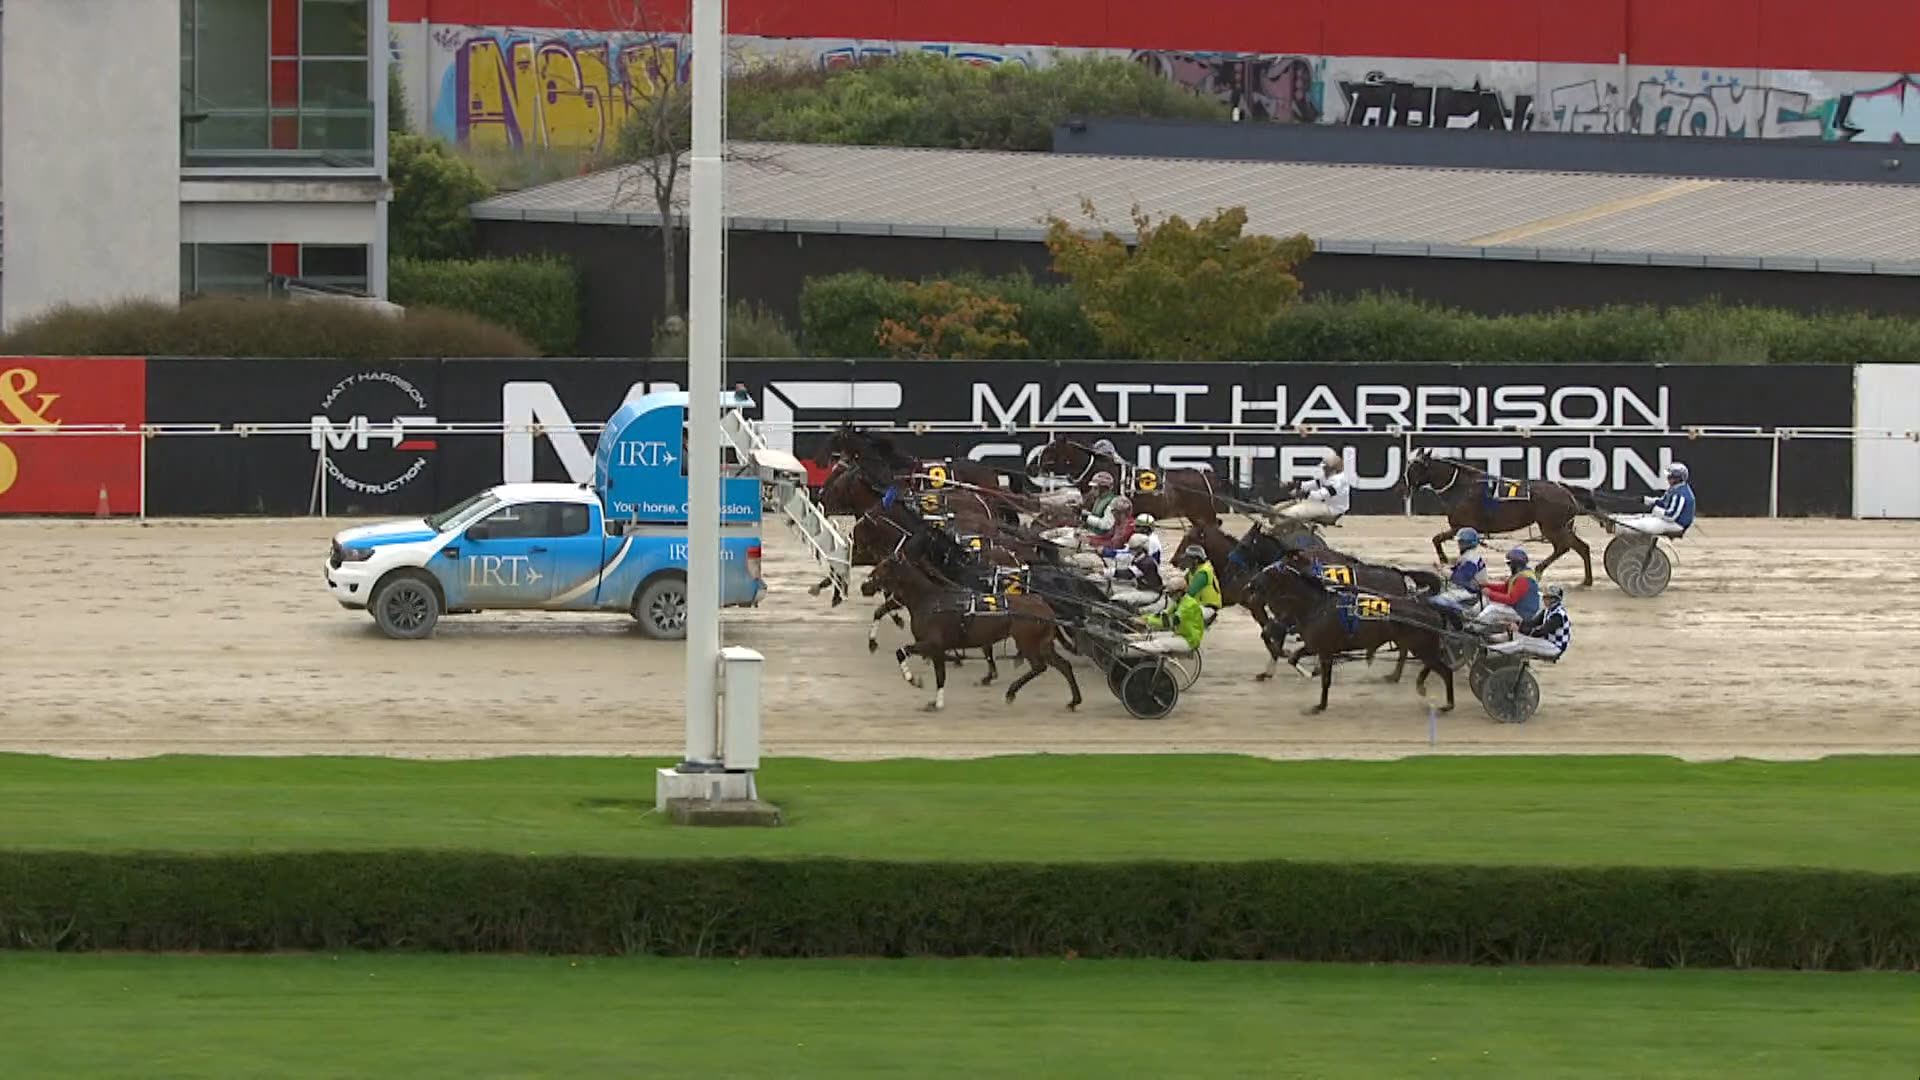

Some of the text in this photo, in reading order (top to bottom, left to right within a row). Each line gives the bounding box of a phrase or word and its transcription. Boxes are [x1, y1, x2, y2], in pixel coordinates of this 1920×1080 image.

[321, 372, 427, 409] MATT HARRISON
[971, 382, 1669, 429] MATT HARRISON
[617, 441, 667, 467] IRT
[323, 456, 427, 494] CONSTRUCTION
[1503, 480, 1521, 498] 7
[468, 554, 528, 586] IRT
[1323, 568, 1351, 585] 11
